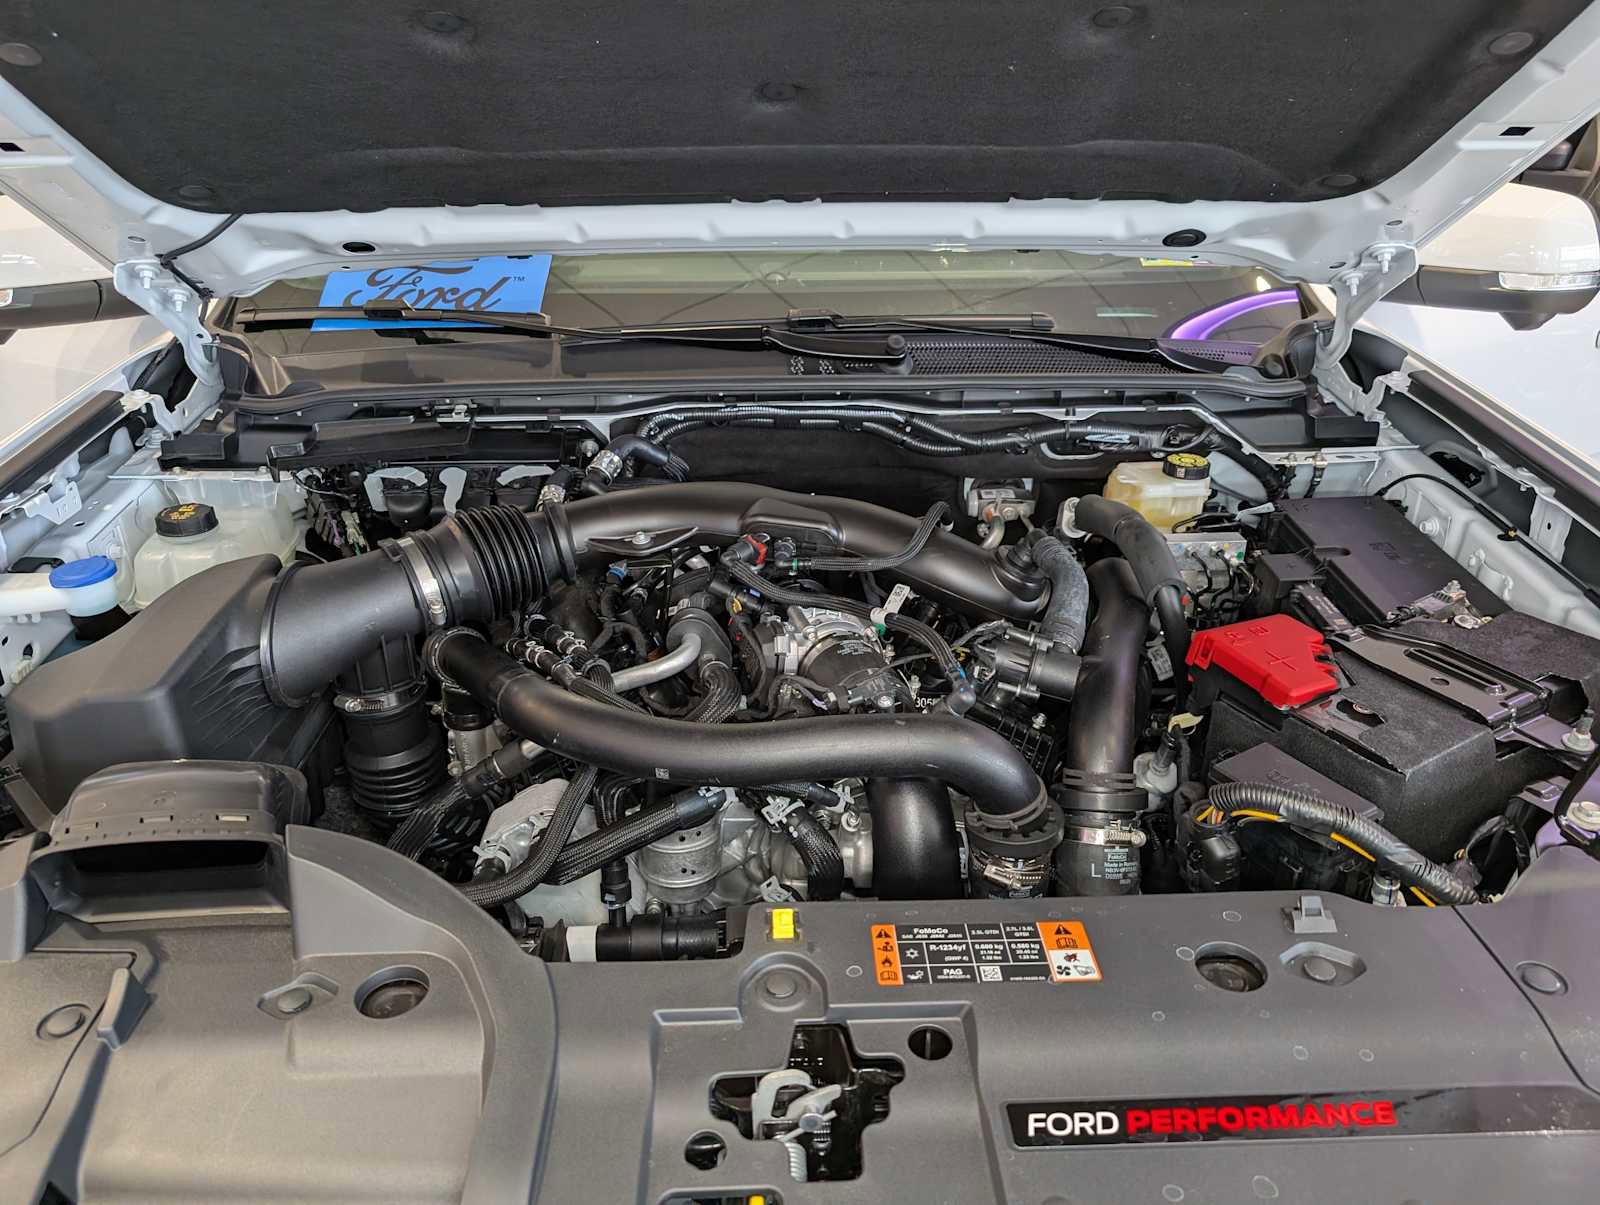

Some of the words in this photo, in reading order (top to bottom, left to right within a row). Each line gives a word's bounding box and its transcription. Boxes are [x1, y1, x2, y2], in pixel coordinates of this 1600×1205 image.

[342, 260, 511, 312] Ford
[1091, 863, 1102, 878] L
[929, 943, 966, 952] R-1234yf
[1028, 1111, 1119, 1137] FORD
[1126, 1100, 1398, 1135] PERFORMANCE
